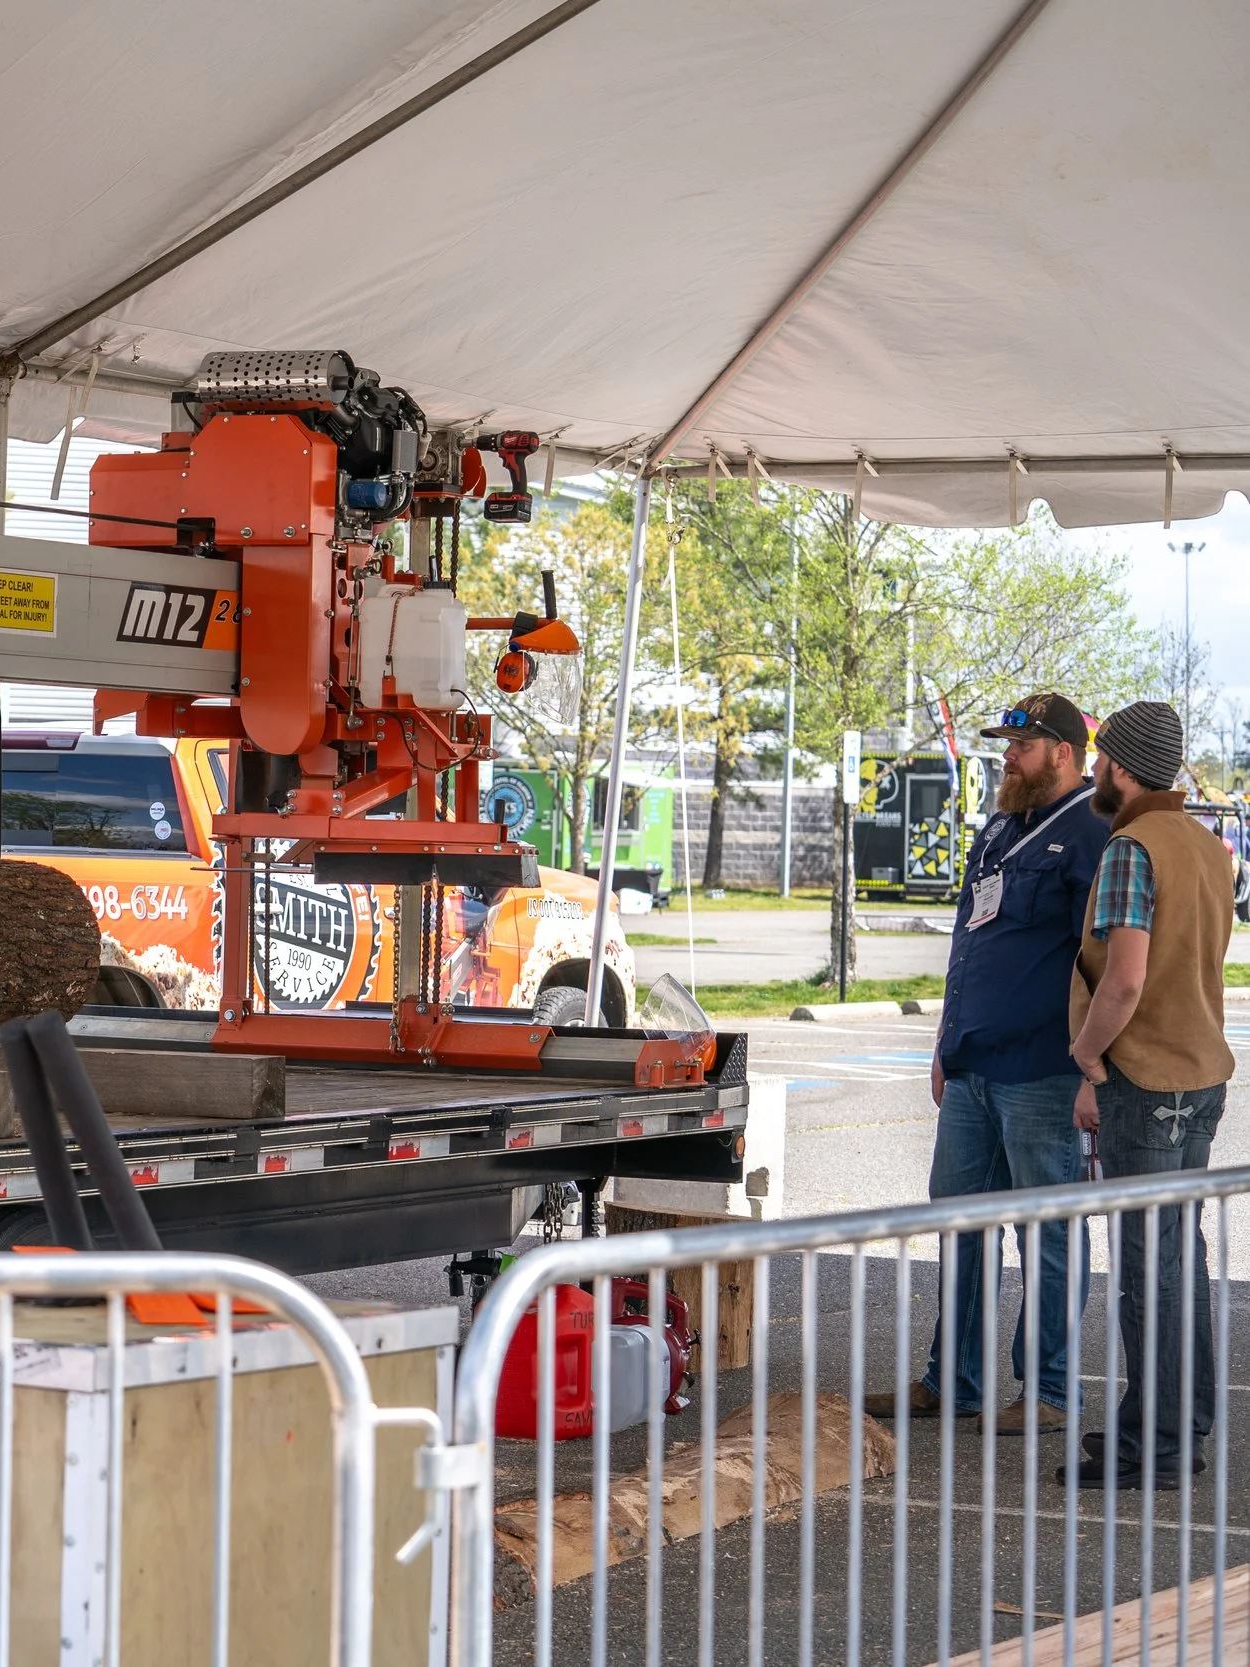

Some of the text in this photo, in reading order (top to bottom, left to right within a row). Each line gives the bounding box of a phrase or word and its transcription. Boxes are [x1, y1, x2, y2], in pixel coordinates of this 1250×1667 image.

[8, 579, 34, 593] CLEAR!
[13, 597, 31, 608] AWAY
[31, 598, 50, 610] FROM
[9, 609, 23, 620] FOR
[23, 611, 48, 623] INJURY!
[81, 885, 188, 920] 98-6344
[527, 899, 538, 917] US
[269, 941, 336, 993] SERVICE
[287, 948, 312, 971] 1990
